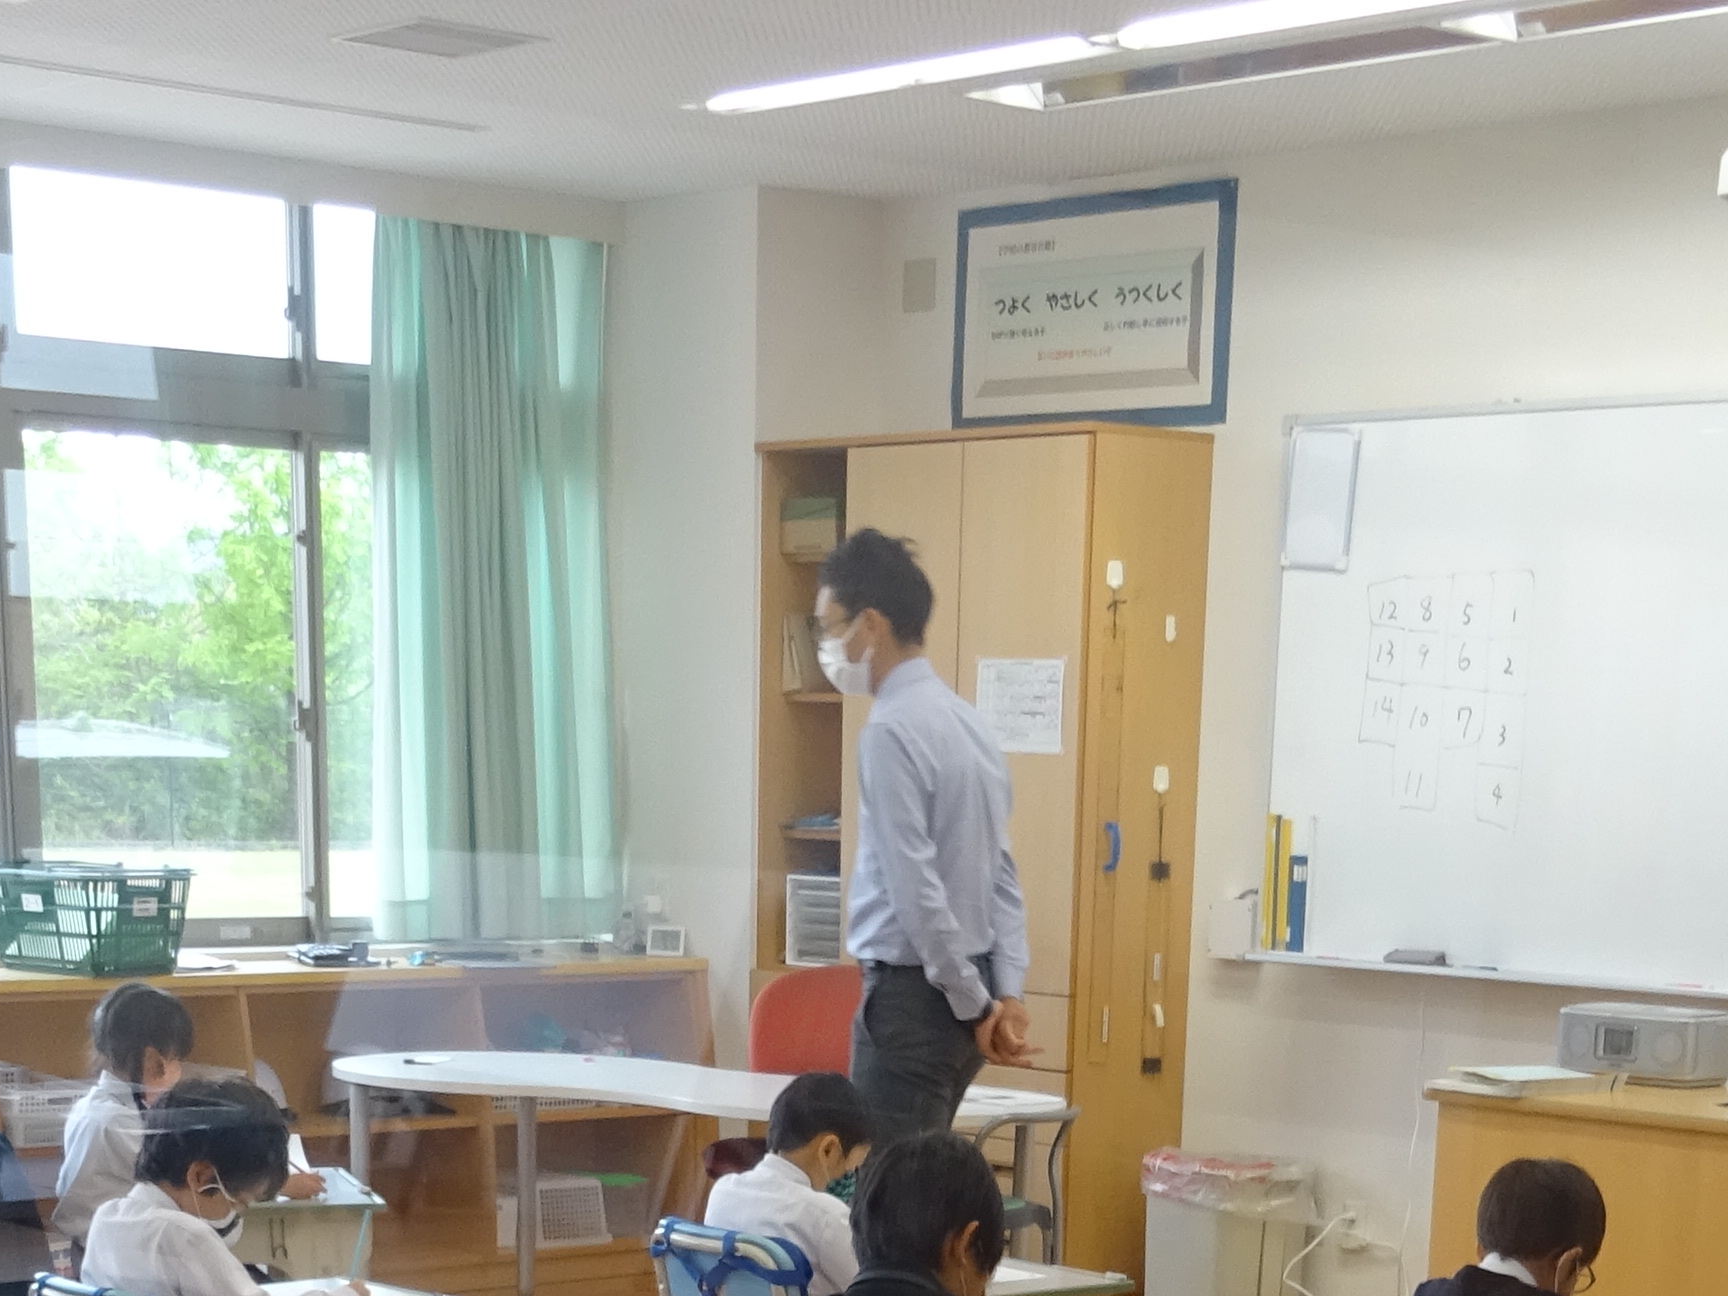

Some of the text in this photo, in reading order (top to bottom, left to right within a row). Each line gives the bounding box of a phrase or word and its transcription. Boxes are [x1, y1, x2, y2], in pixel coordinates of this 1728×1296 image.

[993, 280, 1183, 316] つよく やさしく うつくしく
[1379, 600, 1397, 621] 12
[1420, 595, 1432, 622] 8
[1463, 601, 1474, 625] 5
[1376, 640, 1513, 676] 13 9 6 2
[1373, 695, 1507, 748] 14 10 7 3
[1491, 782, 1503, 806] 4
